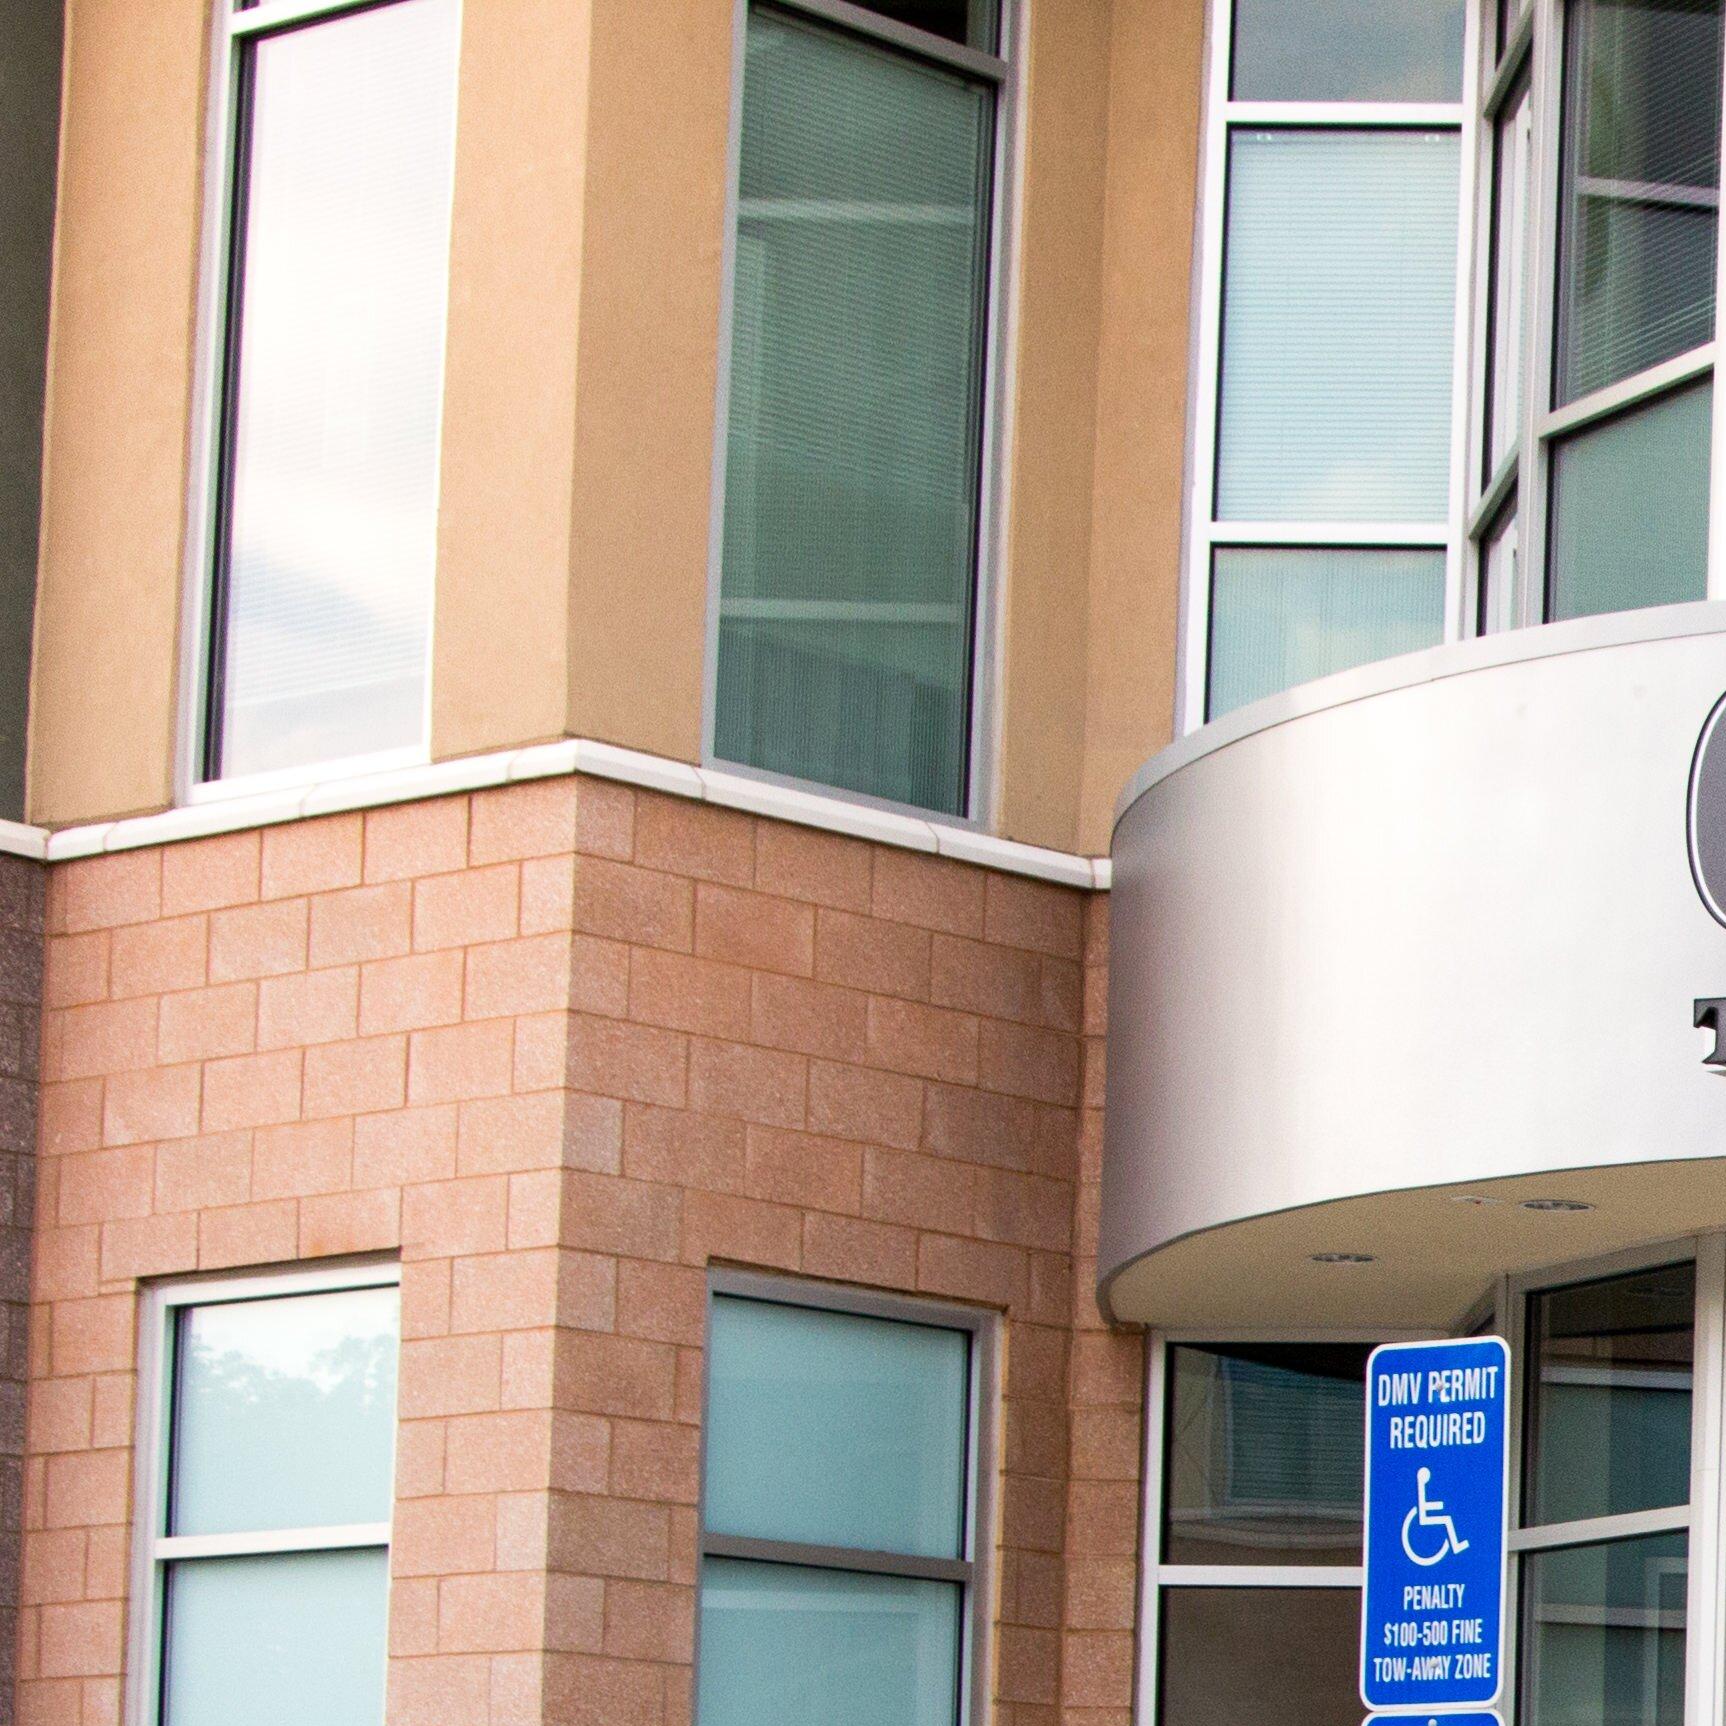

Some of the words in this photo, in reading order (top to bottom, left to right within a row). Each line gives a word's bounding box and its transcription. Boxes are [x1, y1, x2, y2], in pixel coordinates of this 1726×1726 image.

[1378, 1373, 1420, 1407] DMV
[1429, 1365, 1498, 1404] PERMIT
[1390, 1411, 1485, 1449] REQUIRED
[1403, 1583, 1465, 1610] PENALTY
[1384, 1621, 1448, 1647] $100-500
[1453, 1621, 1482, 1644] FINE
[1374, 1655, 1450, 1682] TOW-AWAY
[1455, 1653, 1491, 1680] ZONE
